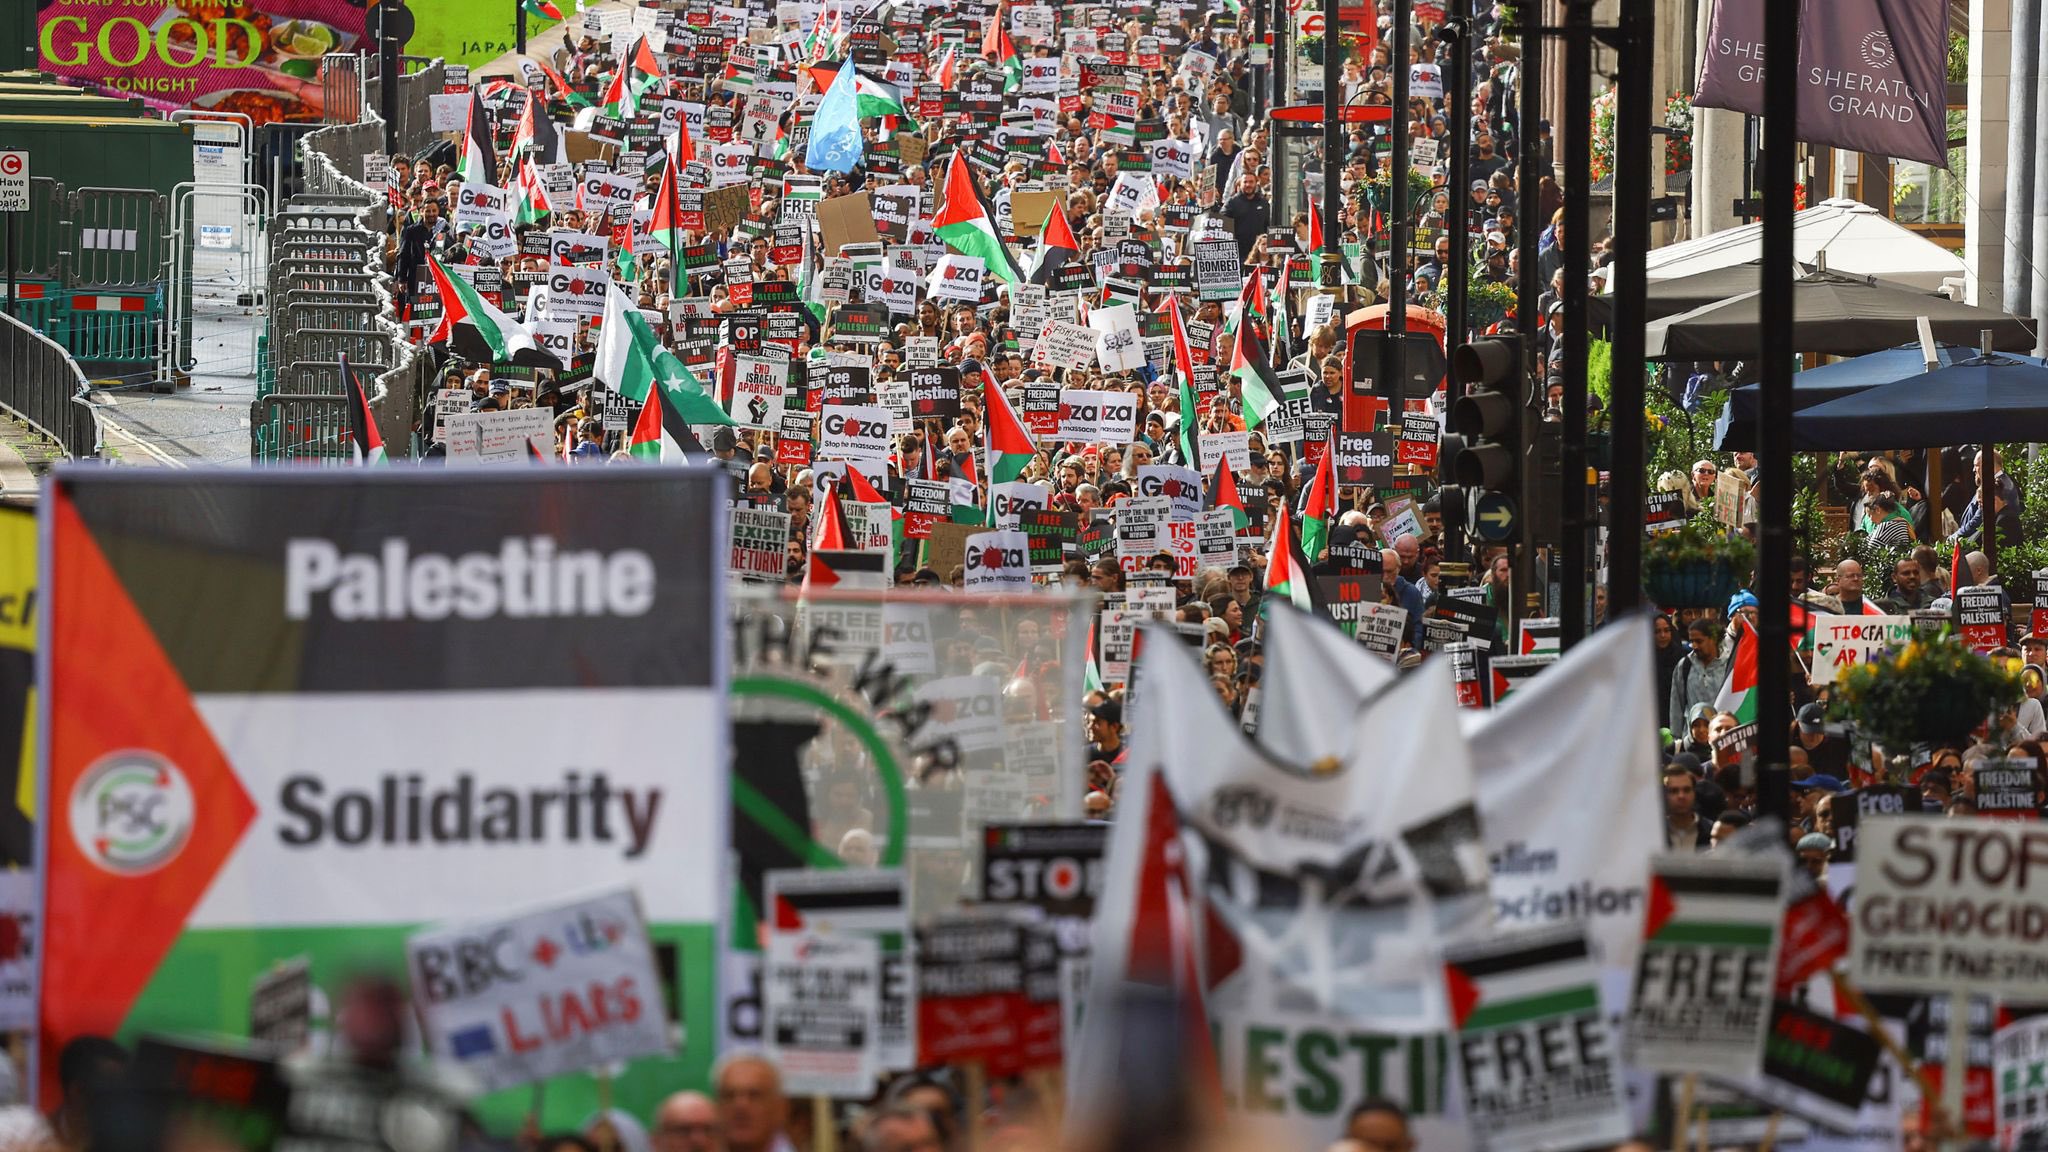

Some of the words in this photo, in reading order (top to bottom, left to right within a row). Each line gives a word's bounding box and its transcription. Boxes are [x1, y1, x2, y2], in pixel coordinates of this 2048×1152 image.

[852, 24, 880, 34] STOP
[40, 15, 262, 69] GOOD
[698, 36, 722, 45] STOP
[462, 42, 516, 55] JAPA
[103, 77, 199, 92] TONIGHT
[971, 82, 992, 92] Free
[1808, 66, 1929, 109] SHERATON
[961, 92, 1001, 101] Palestine
[1110, 94, 1134, 107] FREE
[1829, 95, 1914, 124] GRAND
[0, 177, 24, 186] Have
[2, 190, 21, 198] you
[587, 180, 631, 200] Gza
[461, 189, 501, 210] Gza
[875, 198, 897, 212] Free
[1168, 205, 1202, 214] SANCTIONS
[525, 236, 550, 245] FREEDOM
[775, 238, 801, 246] PALESTINE
[1196, 243, 1218, 251] ISRAELI
[1219, 242, 1237, 250] STATE
[523, 246, 550, 255] PALESTINE
[1122, 242, 1146, 255] Free
[1093, 249, 1119, 267] FREEDOM
[1197, 250, 1238, 260] TERRORISTS
[727, 265, 750, 274] FREEDOM
[895, 260, 918, 268] ISRAELI
[1200, 260, 1238, 273] BOMBED
[728, 276, 752, 284] PALESTINE
[1060, 273, 1090, 283] BOMBING
[1154, 272, 1186, 280] BOMBING
[475, 284, 501, 292] PALESTINE
[551, 274, 606, 296] Gza
[765, 284, 783, 293] FREE
[869, 273, 914, 295] Gza
[948, 284, 977, 293] massacre
[550, 297, 564, 305] Stop
[754, 292, 794, 301] PALESTINE
[1202, 291, 1216, 299] FREE
[414, 302, 439, 311] BOMBING
[684, 305, 697, 313] END
[770, 319, 796, 327] FREEDOM
[848, 314, 869, 323] FREE
[837, 322, 880, 332] PALESTINE
[1053, 325, 1075, 337] FISHY
[1189, 327, 1211, 339] FREEDOM
[768, 330, 797, 339] PALESTINE
[678, 339, 711, 351] SANCTIONS
[762, 349, 789, 359] FREEDOM
[494, 366, 530, 375] PALESTINE
[754, 363, 770, 374] END
[746, 372, 776, 385] ISRAELI
[911, 372, 942, 386] Free
[738, 382, 782, 396] APARTHEID
[1027, 390, 1057, 400] FREEDOM
[1026, 402, 1058, 411] PALESTINE
[1268, 400, 1311, 420] FREE
[783, 418, 810, 428] FREEDOM
[825, 414, 887, 439] Gza
[1405, 420, 1436, 430] FREEDOM
[781, 430, 810, 440] PALESTINE
[1402, 431, 1436, 442] PALESTINE
[824, 440, 839, 450] Stop
[850, 442, 886, 451] massacre
[1340, 435, 1373, 451] Free
[1334, 452, 1390, 467] alestine
[911, 487, 945, 500] FREEDOM
[1141, 475, 1199, 502] Gza
[1380, 488, 1422, 497] PALESTINE
[908, 501, 945, 514] PALESTINE
[1118, 509, 1131, 517] STOP
[1650, 504, 1662, 513] ON
[734, 513, 750, 524] FREE
[752, 513, 786, 529] PALESTINE
[1037, 514, 1062, 526] FREE
[1133, 515, 1149, 523] GAZA!
[735, 525, 786, 541] EXIST!
[1021, 523, 1075, 537] PALESTINE
[1167, 522, 1196, 538] THE
[1083, 530, 1100, 543] FREE
[734, 539, 785, 552] RESIST!
[966, 545, 1024, 570] Gza
[1331, 546, 1382, 562] SANCTIONS
[731, 548, 783, 574] RETURN!
[1351, 558, 1364, 569] ON
[285, 537, 654, 619] Palestine
[981, 575, 994, 583] the
[1339, 582, 1361, 599] NO
[1130, 602, 1144, 610] STOP
[1146, 602, 1156, 610] THE
[1158, 602, 1172, 610] WAR
[1961, 596, 1998, 607] FREEDOM
[1361, 616, 1375, 624] STOP
[1376, 617, 1387, 625] THE
[1389, 620, 1402, 629] WAR
[1960, 612, 2002, 625] PALESTINE
[1375, 624, 1392, 633] GAZA!
[1969, 627, 1997, 637] الحرية
[1426, 628, 1463, 642] FREEDOM
[1834, 644, 1857, 666] ÁR
[734, 617, 843, 676] THE
[853, 648, 960, 782] WAR
[1736, 739, 1747, 752] ON
[1980, 771, 2031, 786] FREEDOM
[1858, 792, 1904, 816] Free
[1978, 792, 2035, 808] PALESTINE
[277, 771, 662, 859] Solidarity
[1861, 894, 2048, 943] GENOCID
[417, 926, 524, 1000] BBC
[1863, 943, 1931, 976] FREE
[1941, 945, 2048, 982] PALESTIN
[1636, 950, 1766, 1000] FREE
[502, 976, 642, 1056] LIARS
[1630, 1006, 1760, 1030] PALESTINE
[1461, 1017, 1607, 1087] FREE
[1467, 1067, 1614, 1117] PALESTINE
